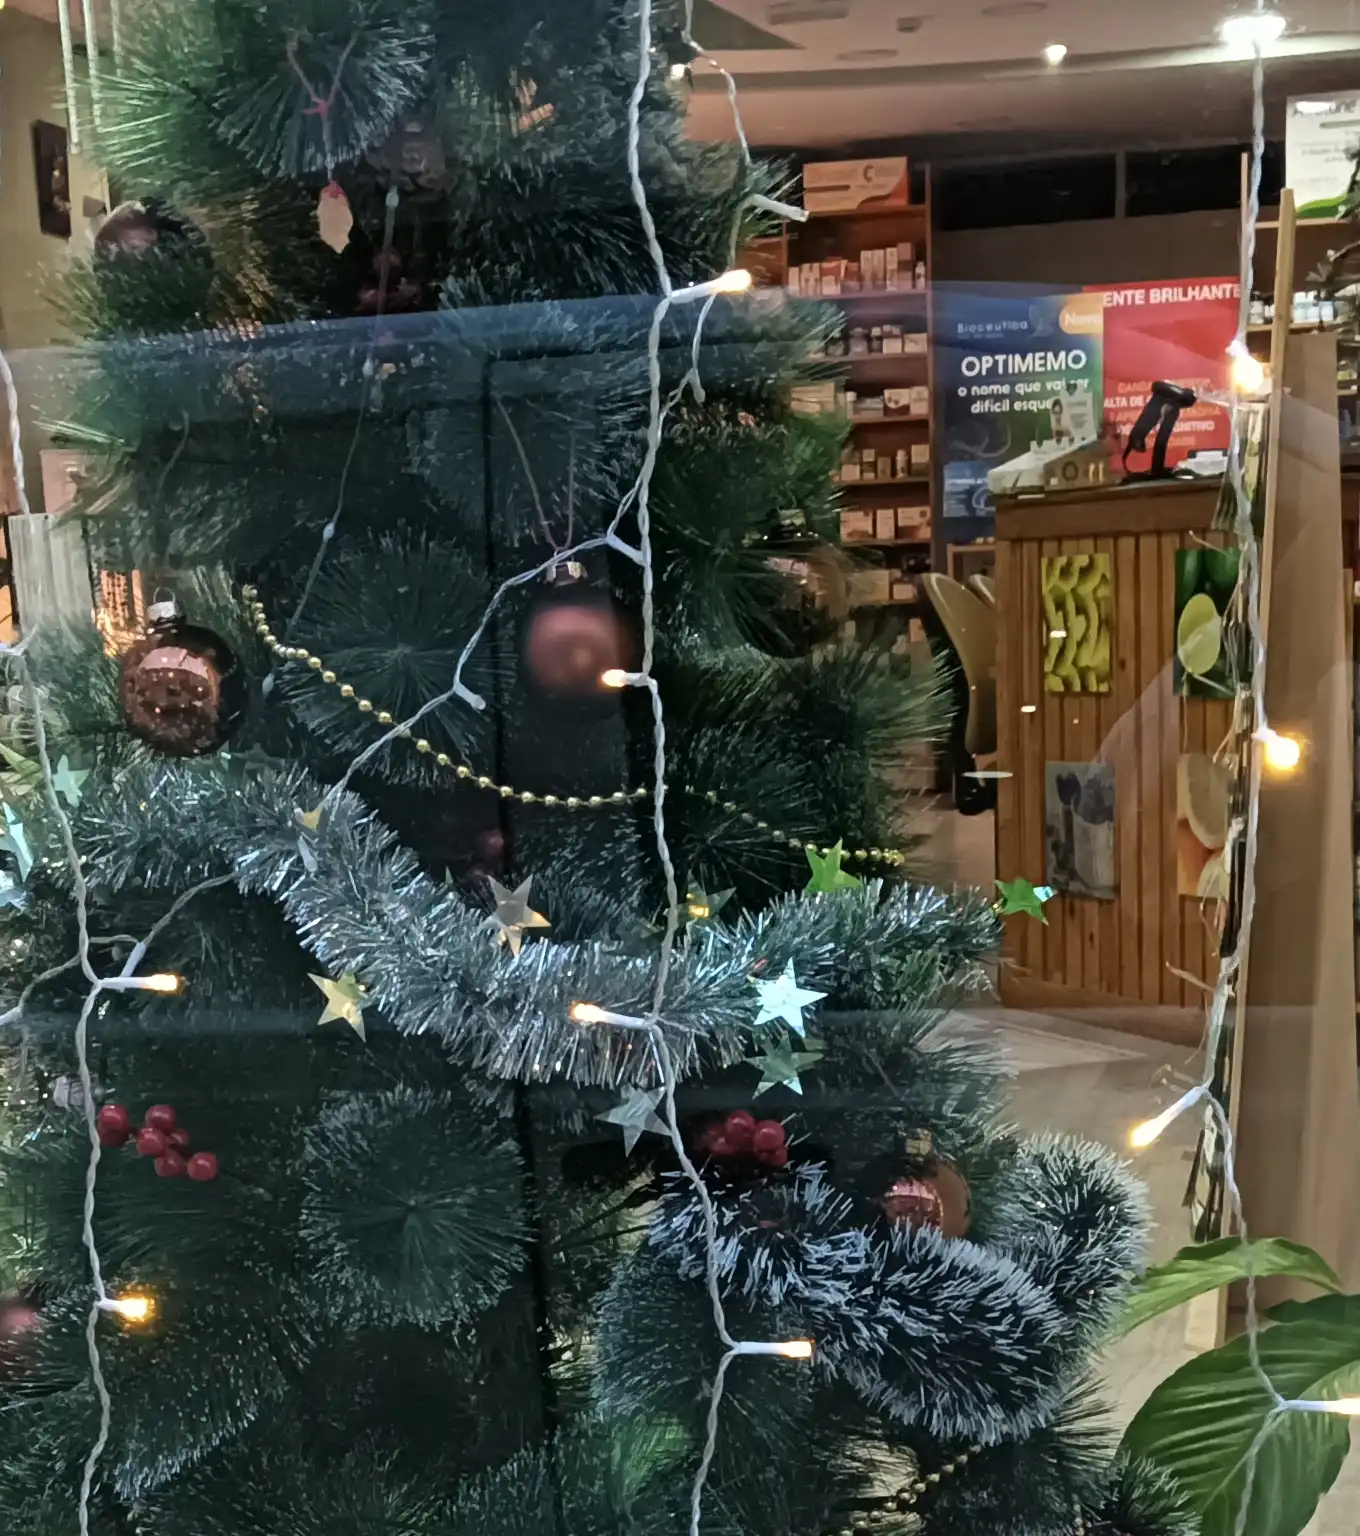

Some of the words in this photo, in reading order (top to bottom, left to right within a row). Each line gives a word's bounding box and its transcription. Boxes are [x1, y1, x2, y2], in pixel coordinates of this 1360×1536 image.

[1103, 289, 1146, 308] ENTE
[1149, 283, 1241, 305] BRILHANTE
[961, 349, 1087, 377] OPTIMEMO
[957, 387, 968, 397] o
[970, 384, 1011, 396] nome
[1015, 382, 1042, 396] que
